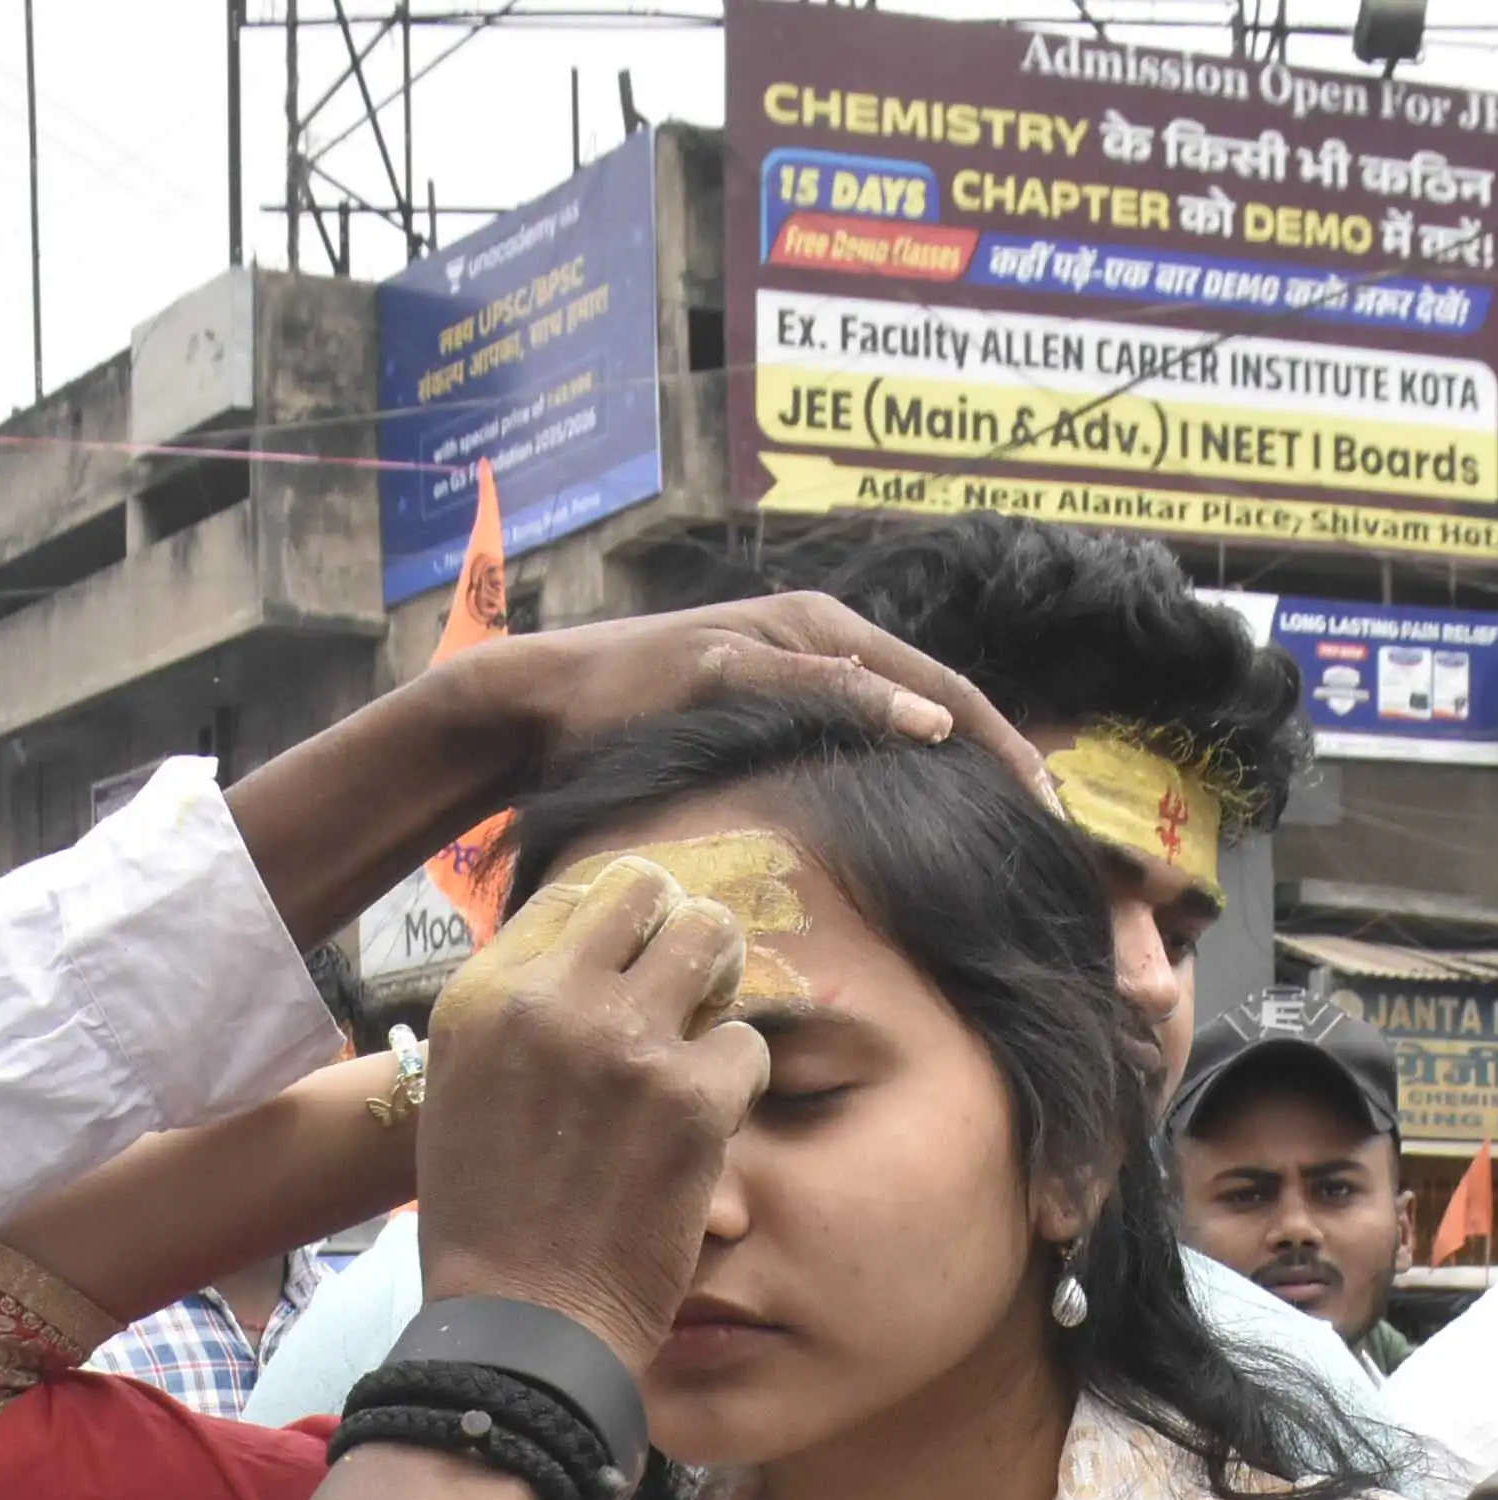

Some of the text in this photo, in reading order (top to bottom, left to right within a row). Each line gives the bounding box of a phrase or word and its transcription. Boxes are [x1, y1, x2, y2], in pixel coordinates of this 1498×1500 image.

[1020, 31, 1249, 101] Admission
[1259, 63, 1369, 119] Open
[1381, 79, 1452, 126] For
[763, 82, 1495, 208] CHEMISTRY के किसी भी कठिन
[780, 165, 927, 219] 15 DAYS
[953, 169, 1170, 231] CHAPTER
[1177, 185, 1236, 238] को
[1244, 202, 1373, 254] DEMO
[1381, 207, 1414, 259] में
[784, 225, 830, 258] Free
[834, 231, 890, 265] Demo
[1203, 267, 1281, 307] DEMO
[778, 308, 1480, 412] Ex. Faculty ALLEN CAREER INSTITUTE KOTA
[778, 386, 853, 431] JEE
[864, 376, 999, 448] (Main
[1009, 406, 1037, 447] &
[1051, 401, 1170, 470] Adv.)
[1202, 421, 1302, 469] NEET
[1333, 434, 1480, 486] Boards
[964, 483, 1045, 512] Near
[1057, 488, 1190, 523] Alankar
[1311, 508, 1430, 544] Shivam
[1279, 612, 1327, 633] LONG
[1328, 615, 1399, 640] LASTING
[1400, 618, 1441, 642] PAIN
[1368, 993, 1484, 1036] JANTA
